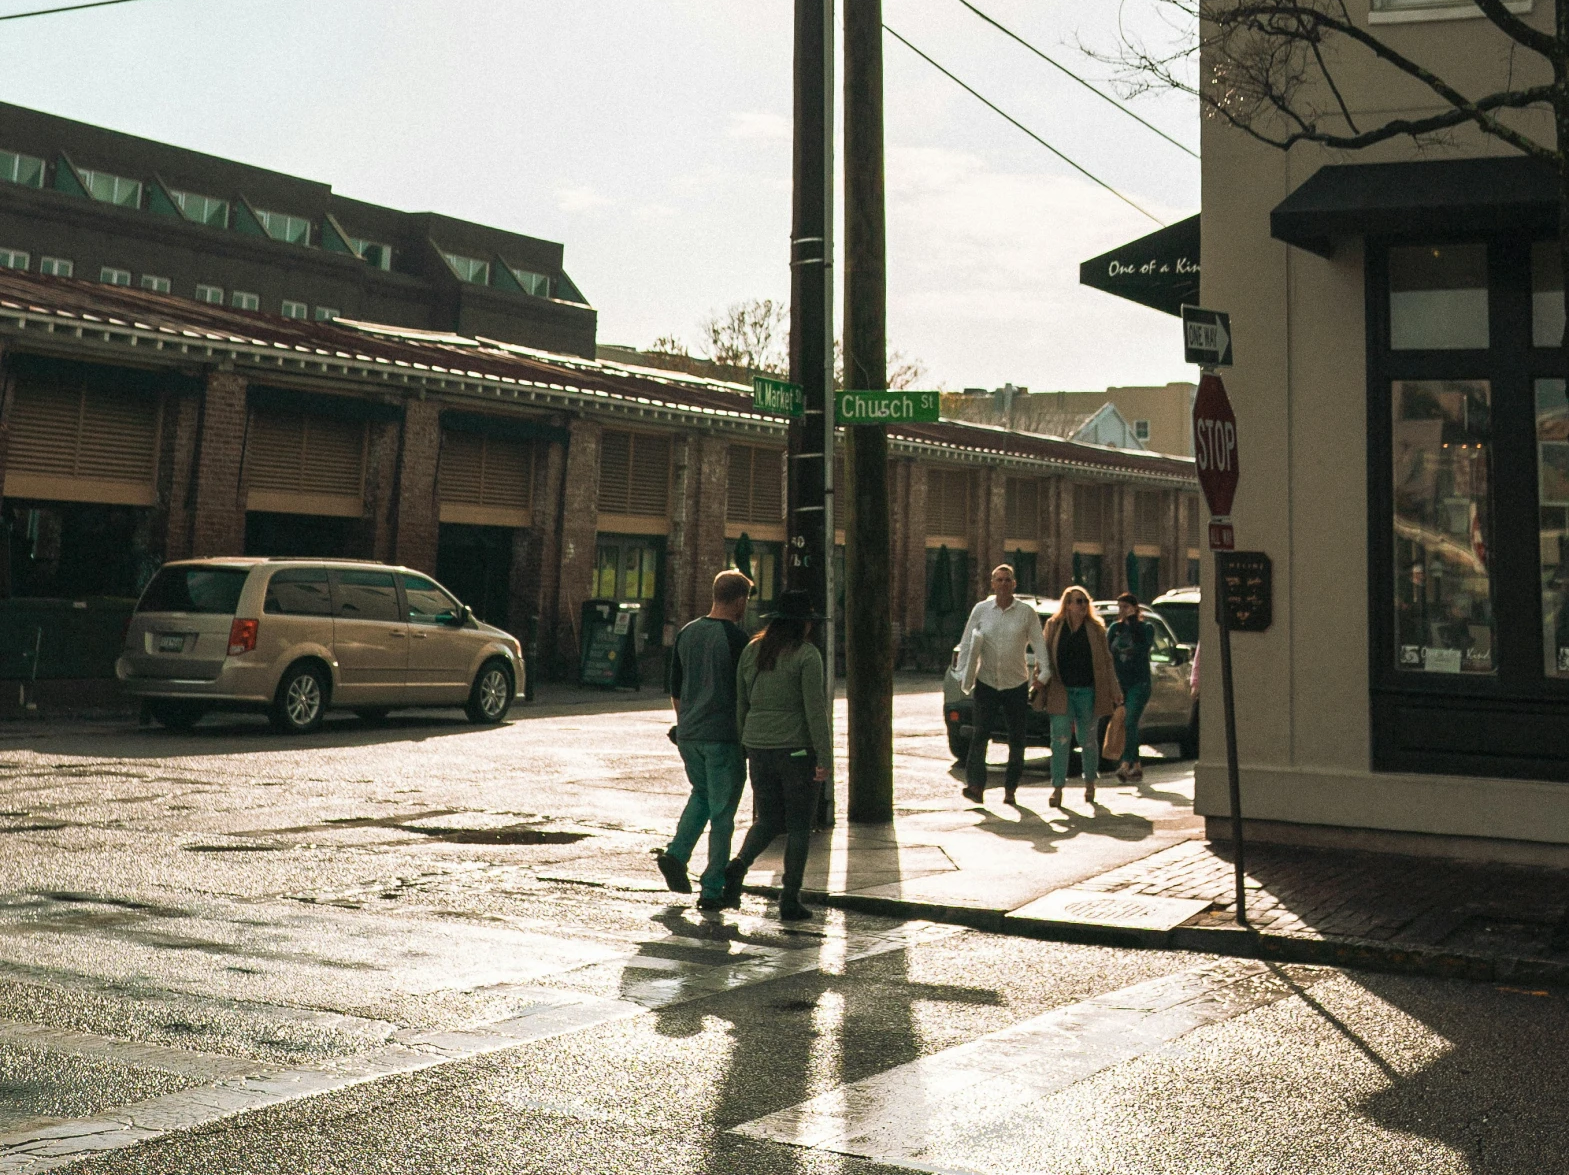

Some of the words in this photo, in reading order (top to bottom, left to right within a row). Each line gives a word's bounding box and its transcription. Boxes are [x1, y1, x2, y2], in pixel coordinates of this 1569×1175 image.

[1108, 260, 1136, 277] One
[1139, 259, 1156, 274] of
[1159, 263, 1170, 273] a
[1189, 324, 1203, 346] ONE
[1204, 326, 1217, 348] WAY
[765, 382, 793, 411] Market
[842, 394, 913, 417] Church
[921, 394, 933, 408] St
[1197, 418, 1235, 472] STOP
